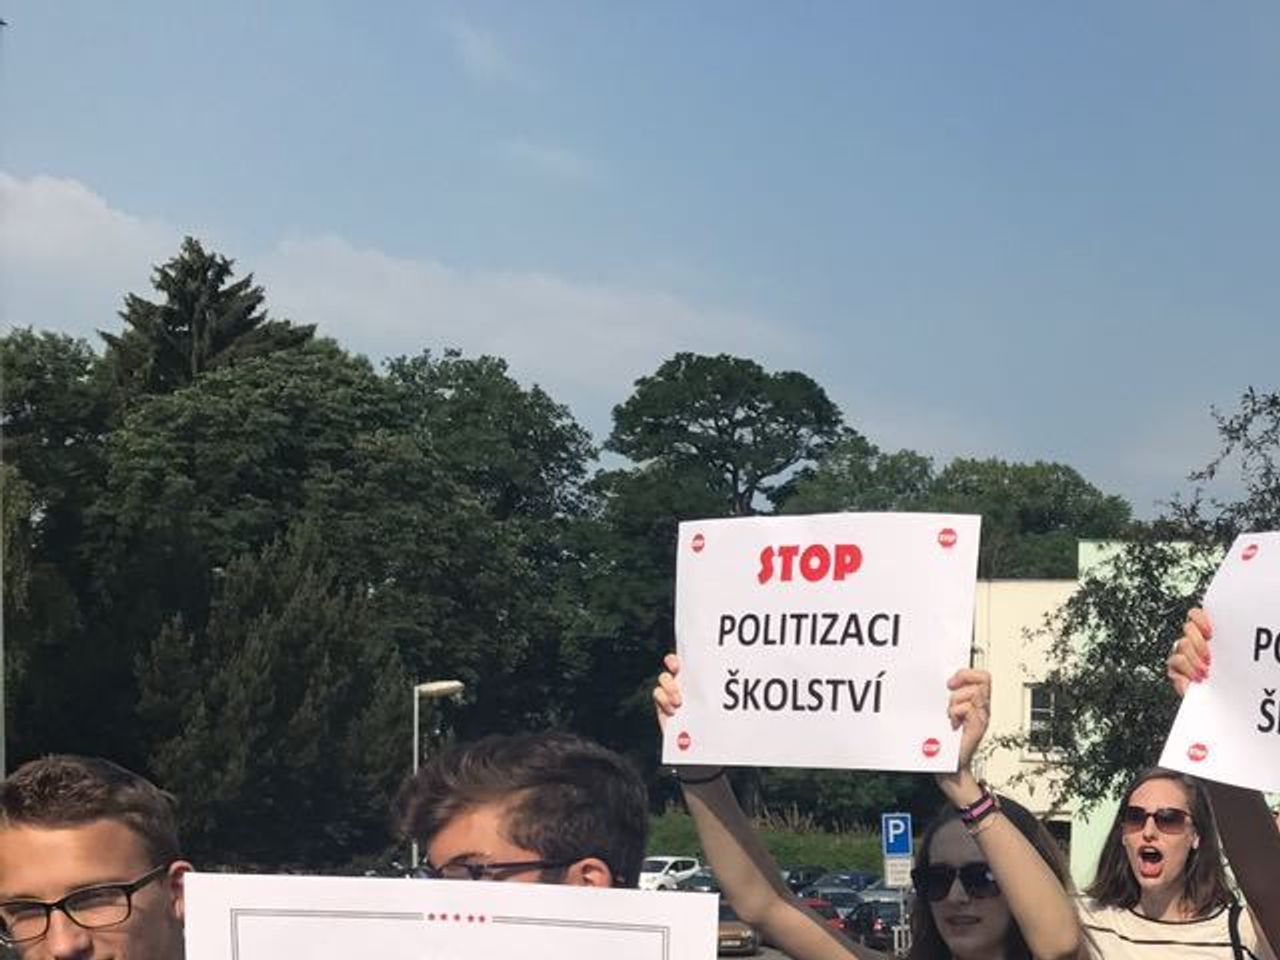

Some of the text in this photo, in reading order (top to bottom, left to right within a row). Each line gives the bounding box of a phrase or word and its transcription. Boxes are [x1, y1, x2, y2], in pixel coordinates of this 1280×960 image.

[758, 543, 863, 585] STOP
[717, 612, 901, 647] POLITIZACI
[722, 668, 887, 713] ŠKOLSTVÍ
[887, 819, 906, 844] P
